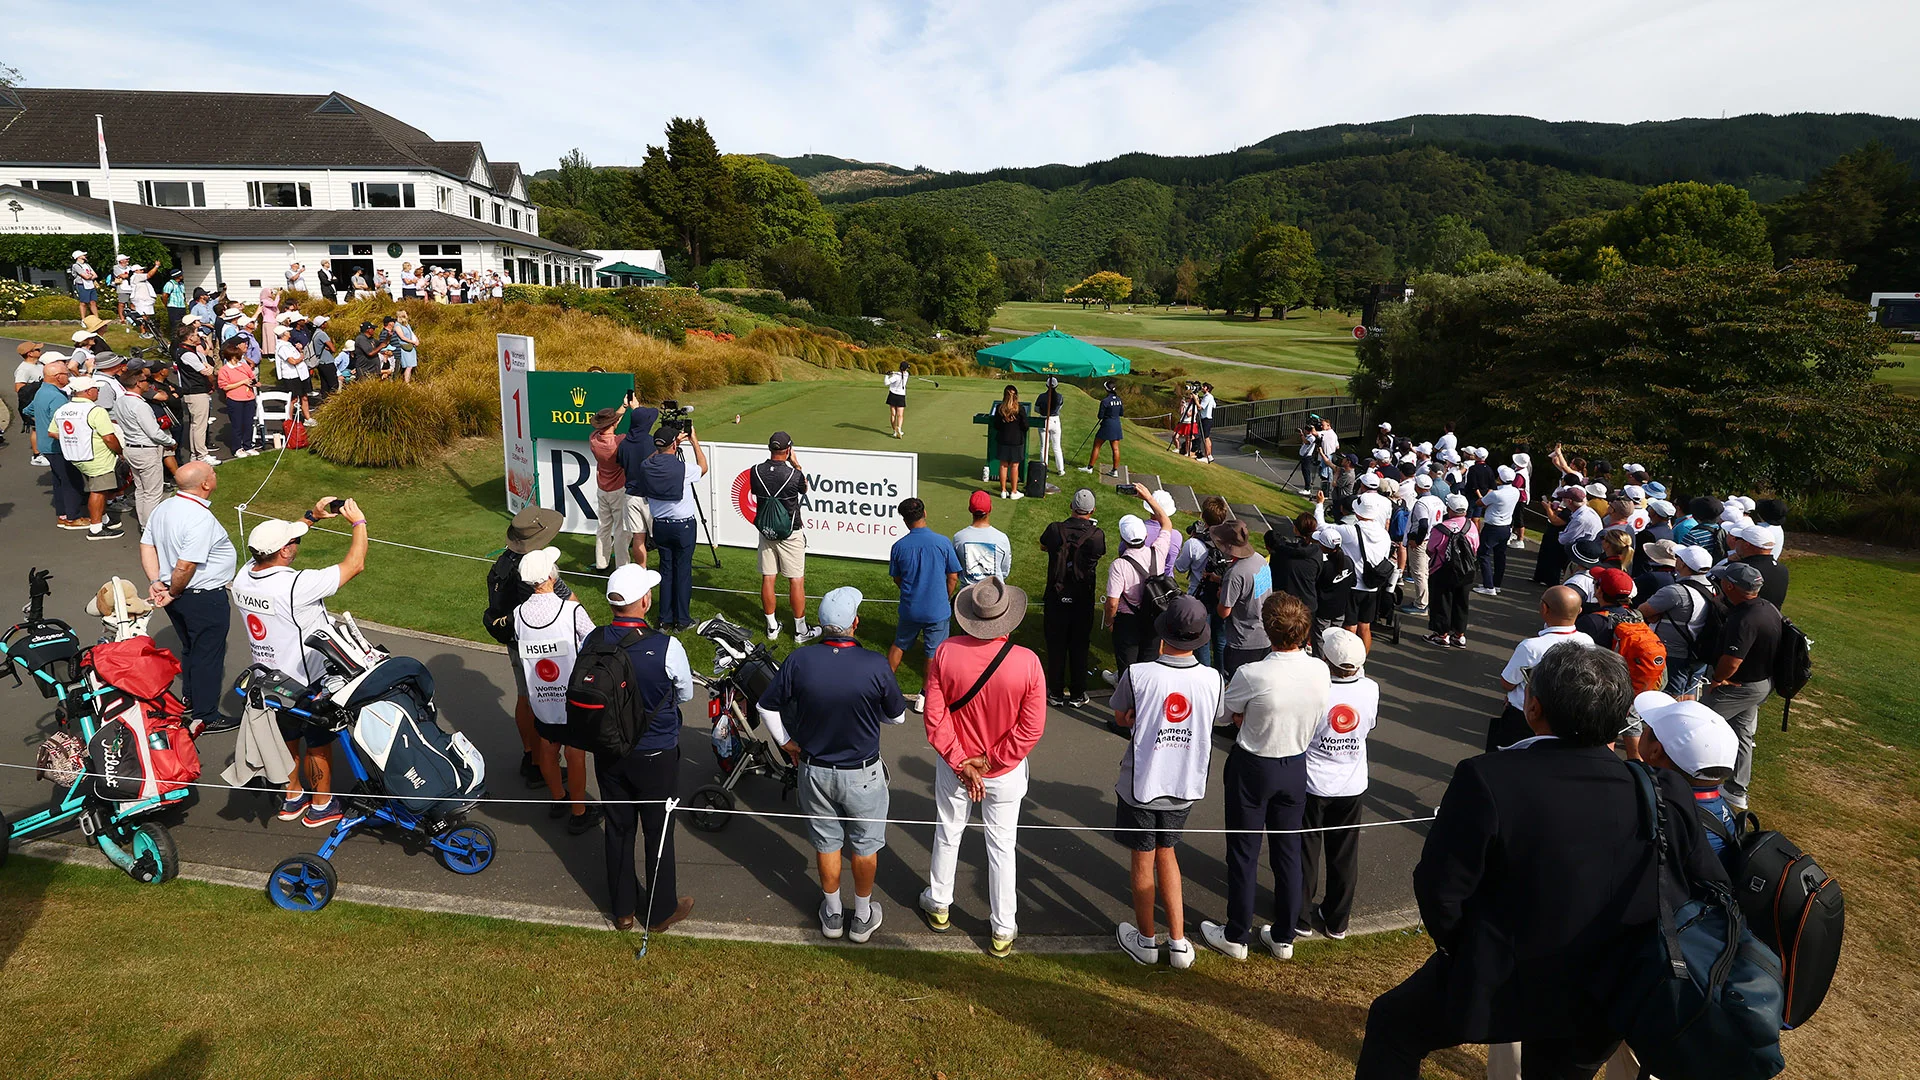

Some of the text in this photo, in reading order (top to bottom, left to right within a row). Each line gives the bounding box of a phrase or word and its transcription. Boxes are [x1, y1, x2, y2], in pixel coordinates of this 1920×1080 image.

[512, 388, 522, 439] 1
[551, 410, 596, 425] ROLE
[806, 473, 898, 497] Women's
[800, 493, 898, 518] Amateur
[837, 521, 897, 536] PACIFIC
[526, 643, 558, 654] HSIEH
[1165, 743, 1191, 751] PACIFIC
[403, 766, 427, 790] WAAC
